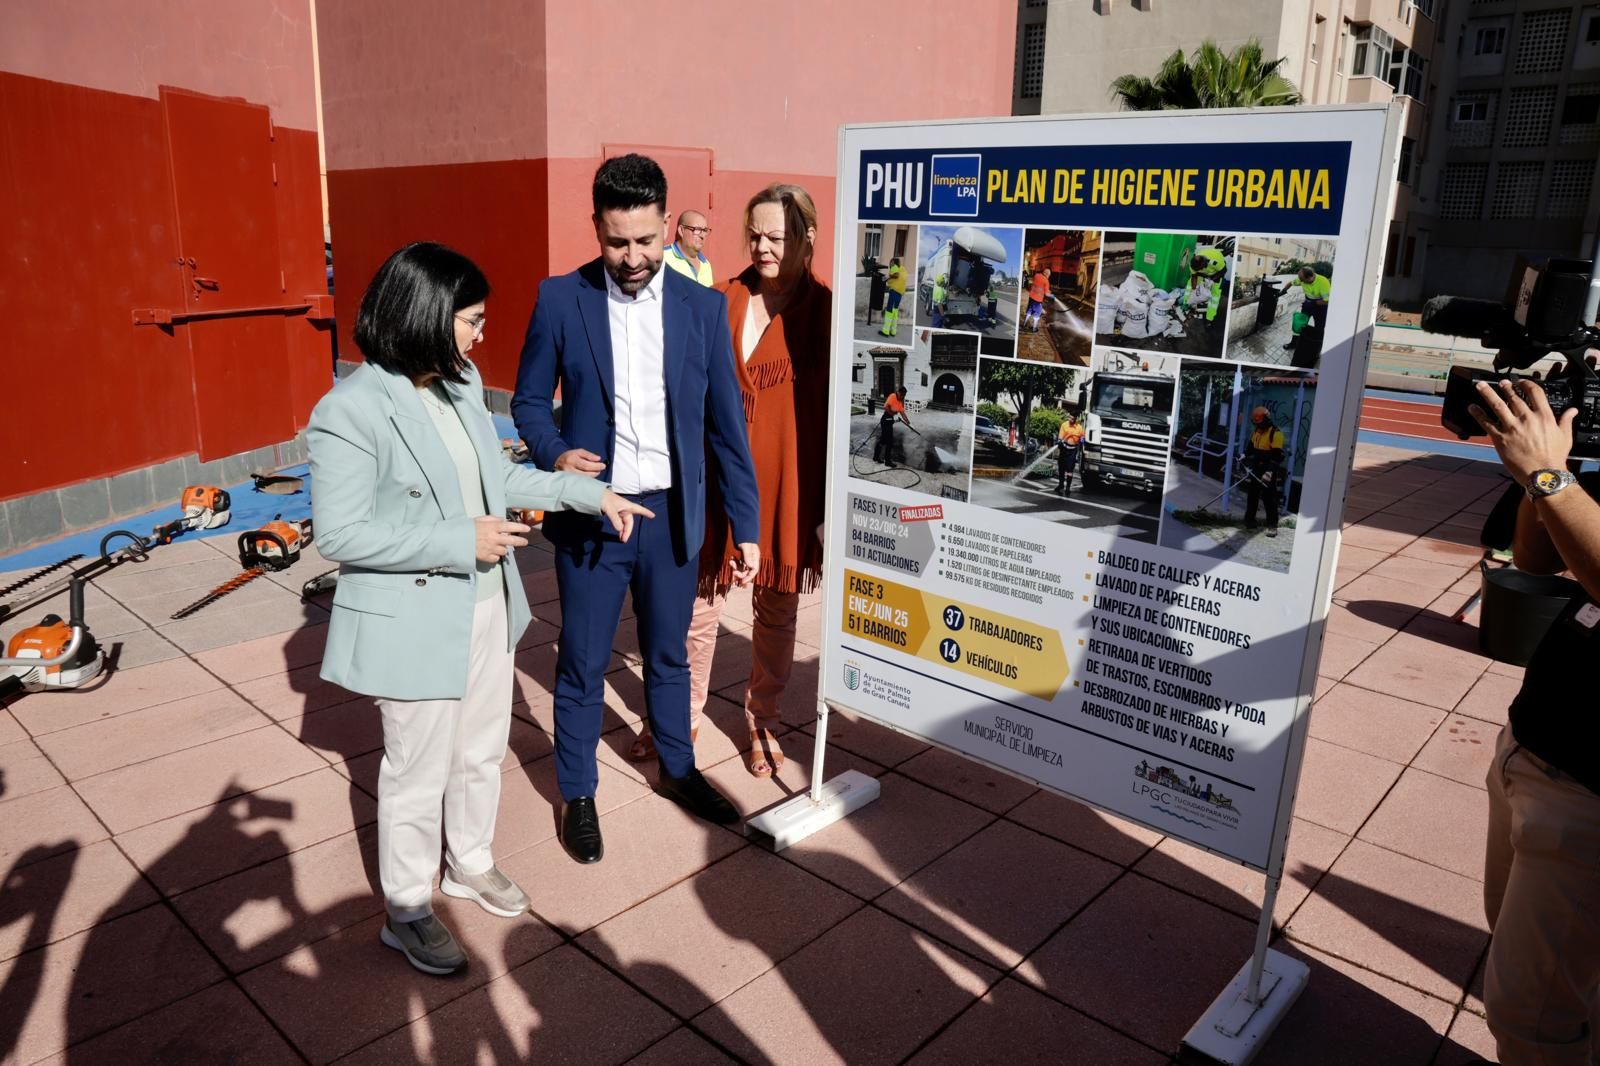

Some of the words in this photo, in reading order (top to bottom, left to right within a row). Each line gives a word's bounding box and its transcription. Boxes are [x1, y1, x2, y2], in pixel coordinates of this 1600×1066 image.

[866, 163, 924, 209] PHU
[933, 175, 977, 188] limpieza
[957, 187, 977, 197] LPA
[986, 169, 1047, 203] PLAN
[1053, 169, 1085, 204] DE
[1092, 169, 1198, 206] HIGIENE
[1205, 169, 1330, 209] URBANA
[1121, 422, 1151, 431] SCANIA
[853, 498, 877, 514] FASES
[879, 504, 883, 515] 1
[885, 505, 891, 517] Y
[892, 507, 898, 519] 2
[901, 507, 941, 520] FINALIZADAS
[852, 514, 868, 527] NOV
[869, 518, 897, 535] 23/DIC
[898, 525, 909, 538] 24
[852, 529, 862, 541] 84
[863, 532, 896, 551] BARRIOS
[965, 527, 991, 541] LAVADOS
[992, 533, 1000, 543] DE
[1001, 535, 1046, 554] CONTENEDORES
[853, 545, 866, 558] 101
[867, 549, 920, 574] ACTUACIONES
[965, 540, 990, 553] LAVADOS
[991, 545, 999, 556] DE
[1000, 548, 1033, 564] PAPELERAS
[963, 563, 982, 576] LITROS
[983, 569, 991, 578] DE
[991, 571, 1037, 591] DESINFECTANTE
[1037, 582, 1074, 601] EMPLEADOS
[980, 555, 1000, 568] LITROS
[1000, 561, 1008, 570] DE
[1008, 562, 1024, 574] AGUA
[1025, 567, 1061, 584] EMPLEADOS
[1098, 550, 1139, 573] BALDEO
[1141, 562, 1156, 577] DE
[1158, 564, 1200, 588] CALLES
[1202, 574, 1211, 590] Y
[1212, 577, 1261, 602] ACERAS
[849, 576, 874, 597] FASE
[876, 584, 884, 600] 3
[974, 578, 982, 588] DE
[982, 580, 1010, 596] RESIDUOS
[1010, 588, 1043, 605] RECOGIDOS
[1096, 572, 1137, 596] LAVADO
[1139, 584, 1154, 600] DE
[1156, 586, 1221, 617] PAPELERAS
[848, 594, 892, 622] ENE/JUN
[894, 609, 909, 628] 25
[1093, 595, 1142, 621] LIMPIEZA
[1144, 607, 1159, 625] DE
[1160, 612, 1251, 650] CONTENEDORES
[848, 613, 860, 632] 51
[863, 618, 907, 647] BARRIOS
[946, 608, 962, 628] 37
[969, 616, 1043, 652] TRABAJADORES
[1091, 615, 1100, 630] Y
[1100, 617, 1121, 636] SUS
[1122, 623, 1194, 657] UBICACIONES
[943, 641, 957, 661] 14
[966, 650, 1018, 680] VEHÍCULOS
[1088, 638, 1139, 666] RETIRADA
[1141, 653, 1156, 671] DE
[1158, 658, 1213, 687] VERTIDOS
[862, 687, 871, 695] de
[871, 690, 886, 701] Gran
[886, 696, 911, 710] Canaria
[863, 672, 912, 696] Ayuntamiento
[874, 684, 886, 693] Las
[888, 688, 911, 702] Palmas
[1086, 658, 1100, 675] DE
[1102, 663, 1151, 692] TRASTOS,
[1153, 679, 1222, 712] ESCOMBROS
[1224, 700, 1234, 715] Y
[1234, 703, 1267, 726] PODA
[1083, 680, 1151, 713] DESBROZADO
[1153, 702, 1168, 719] DE
[1169, 709, 1218, 736] HIERBAS
[1220, 723, 1230, 738] Y
[994, 715, 1034, 741] SERVICIO
[1080, 700, 1135, 729] ARBUSTOS
[1136, 717, 1151, 735] DE
[1152, 723, 1178, 744] VIAS
[1179, 732, 1189, 748] Y
[1189, 736, 1236, 762] ACERAS
[963, 719, 1007, 747] MUNICIPAL
[1008, 736, 1021, 752] DE
[1022, 741, 1064, 768] LIMPIEZA
[1132, 781, 1171, 805] LPGC
